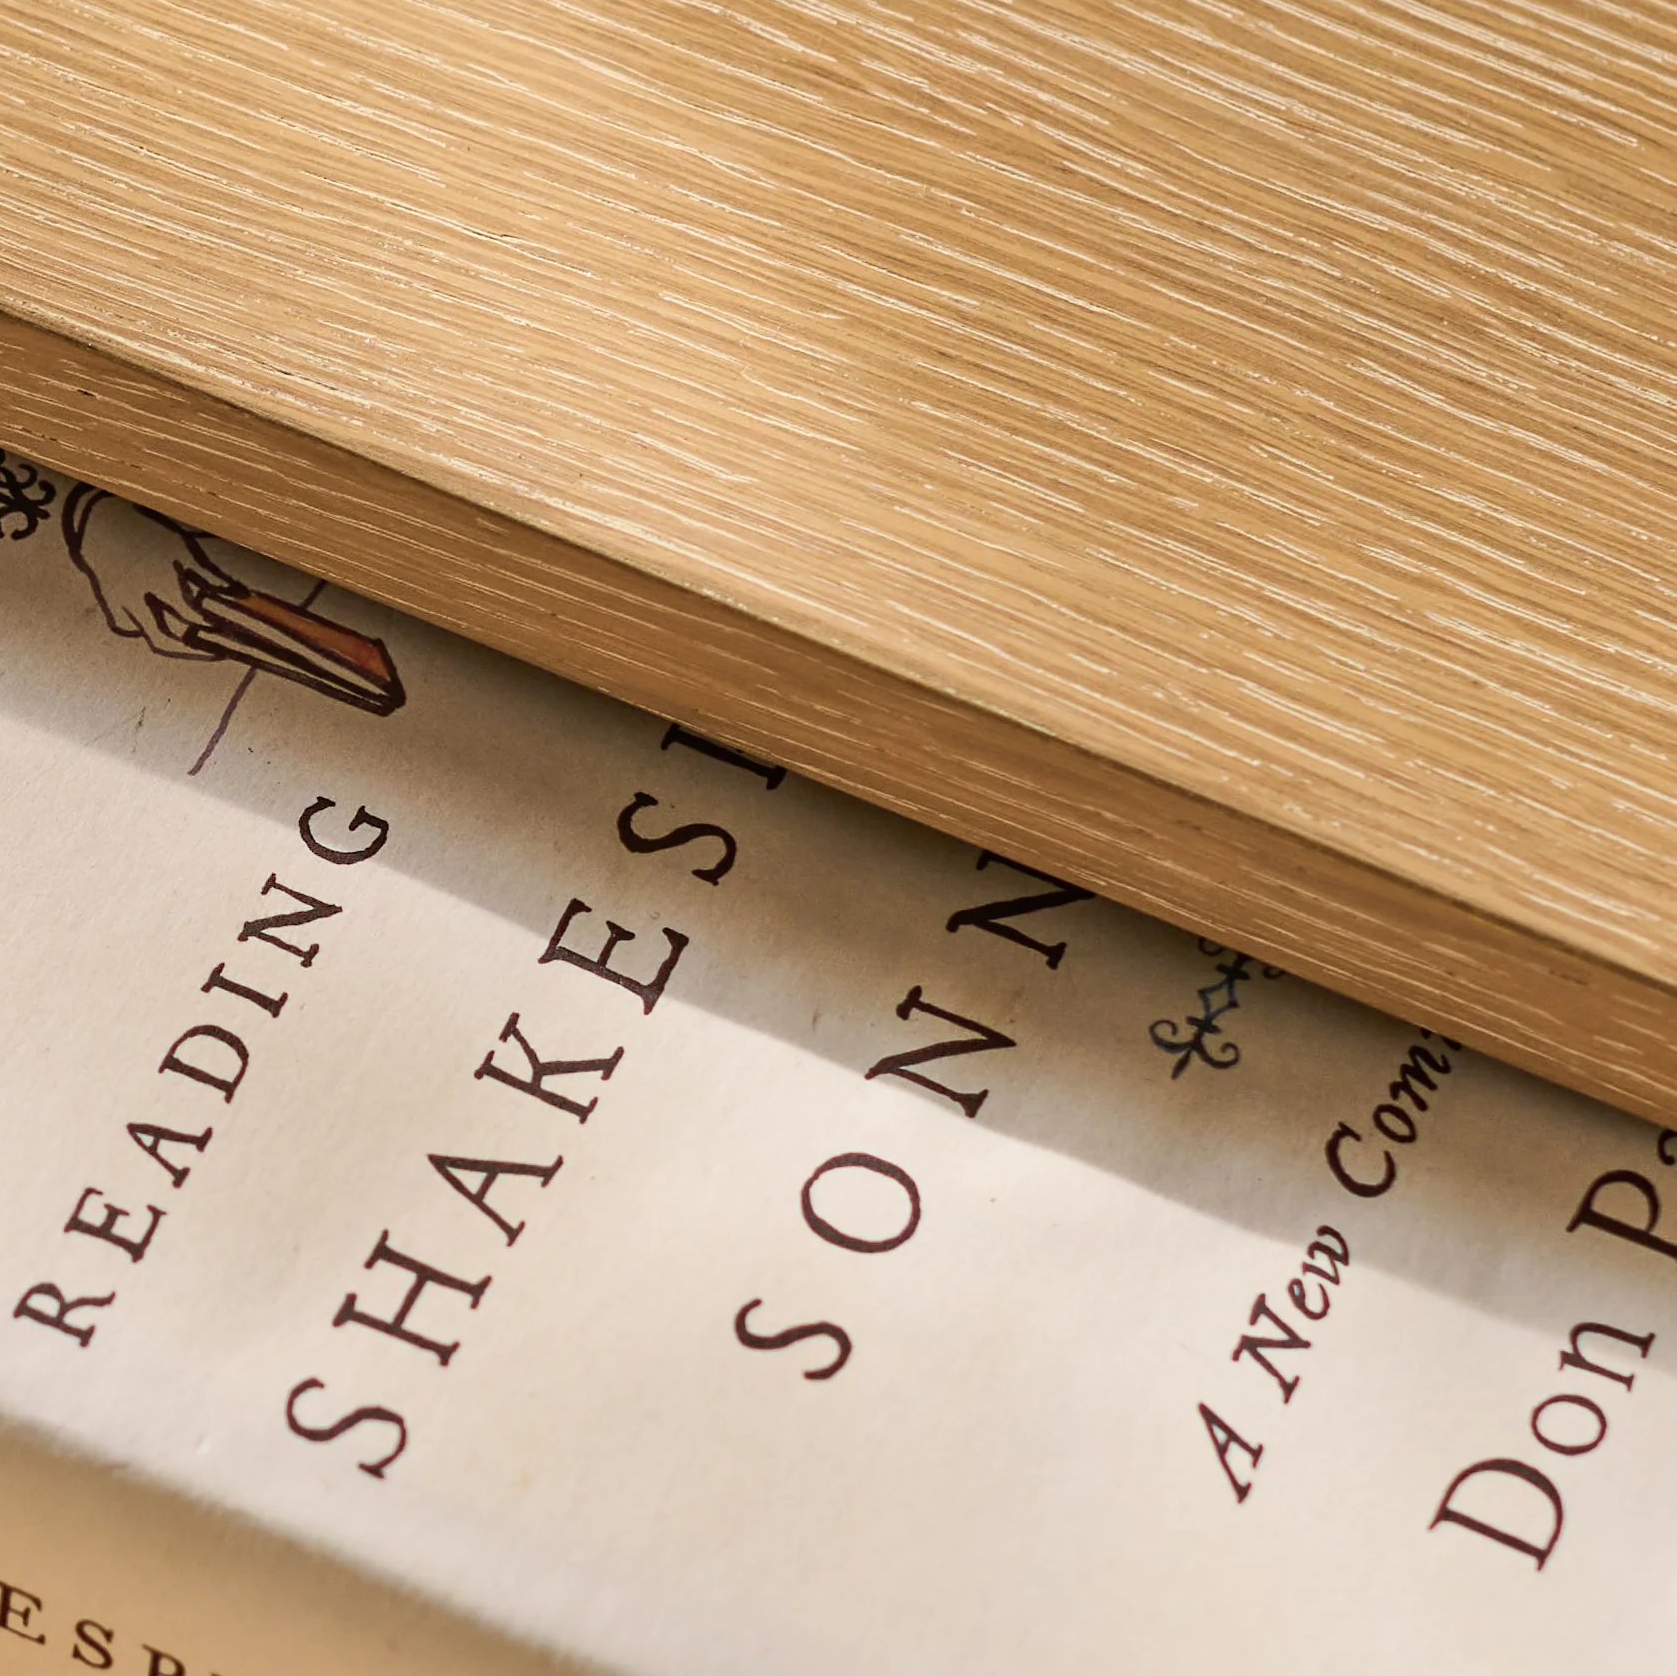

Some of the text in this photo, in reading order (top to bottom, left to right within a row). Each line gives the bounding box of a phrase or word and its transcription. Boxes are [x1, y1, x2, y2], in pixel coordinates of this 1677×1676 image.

[13, 795, 390, 1348] READING
[1198, 1027, 1462, 1504] A New Com
[1428, 1322, 1656, 1572] Don
